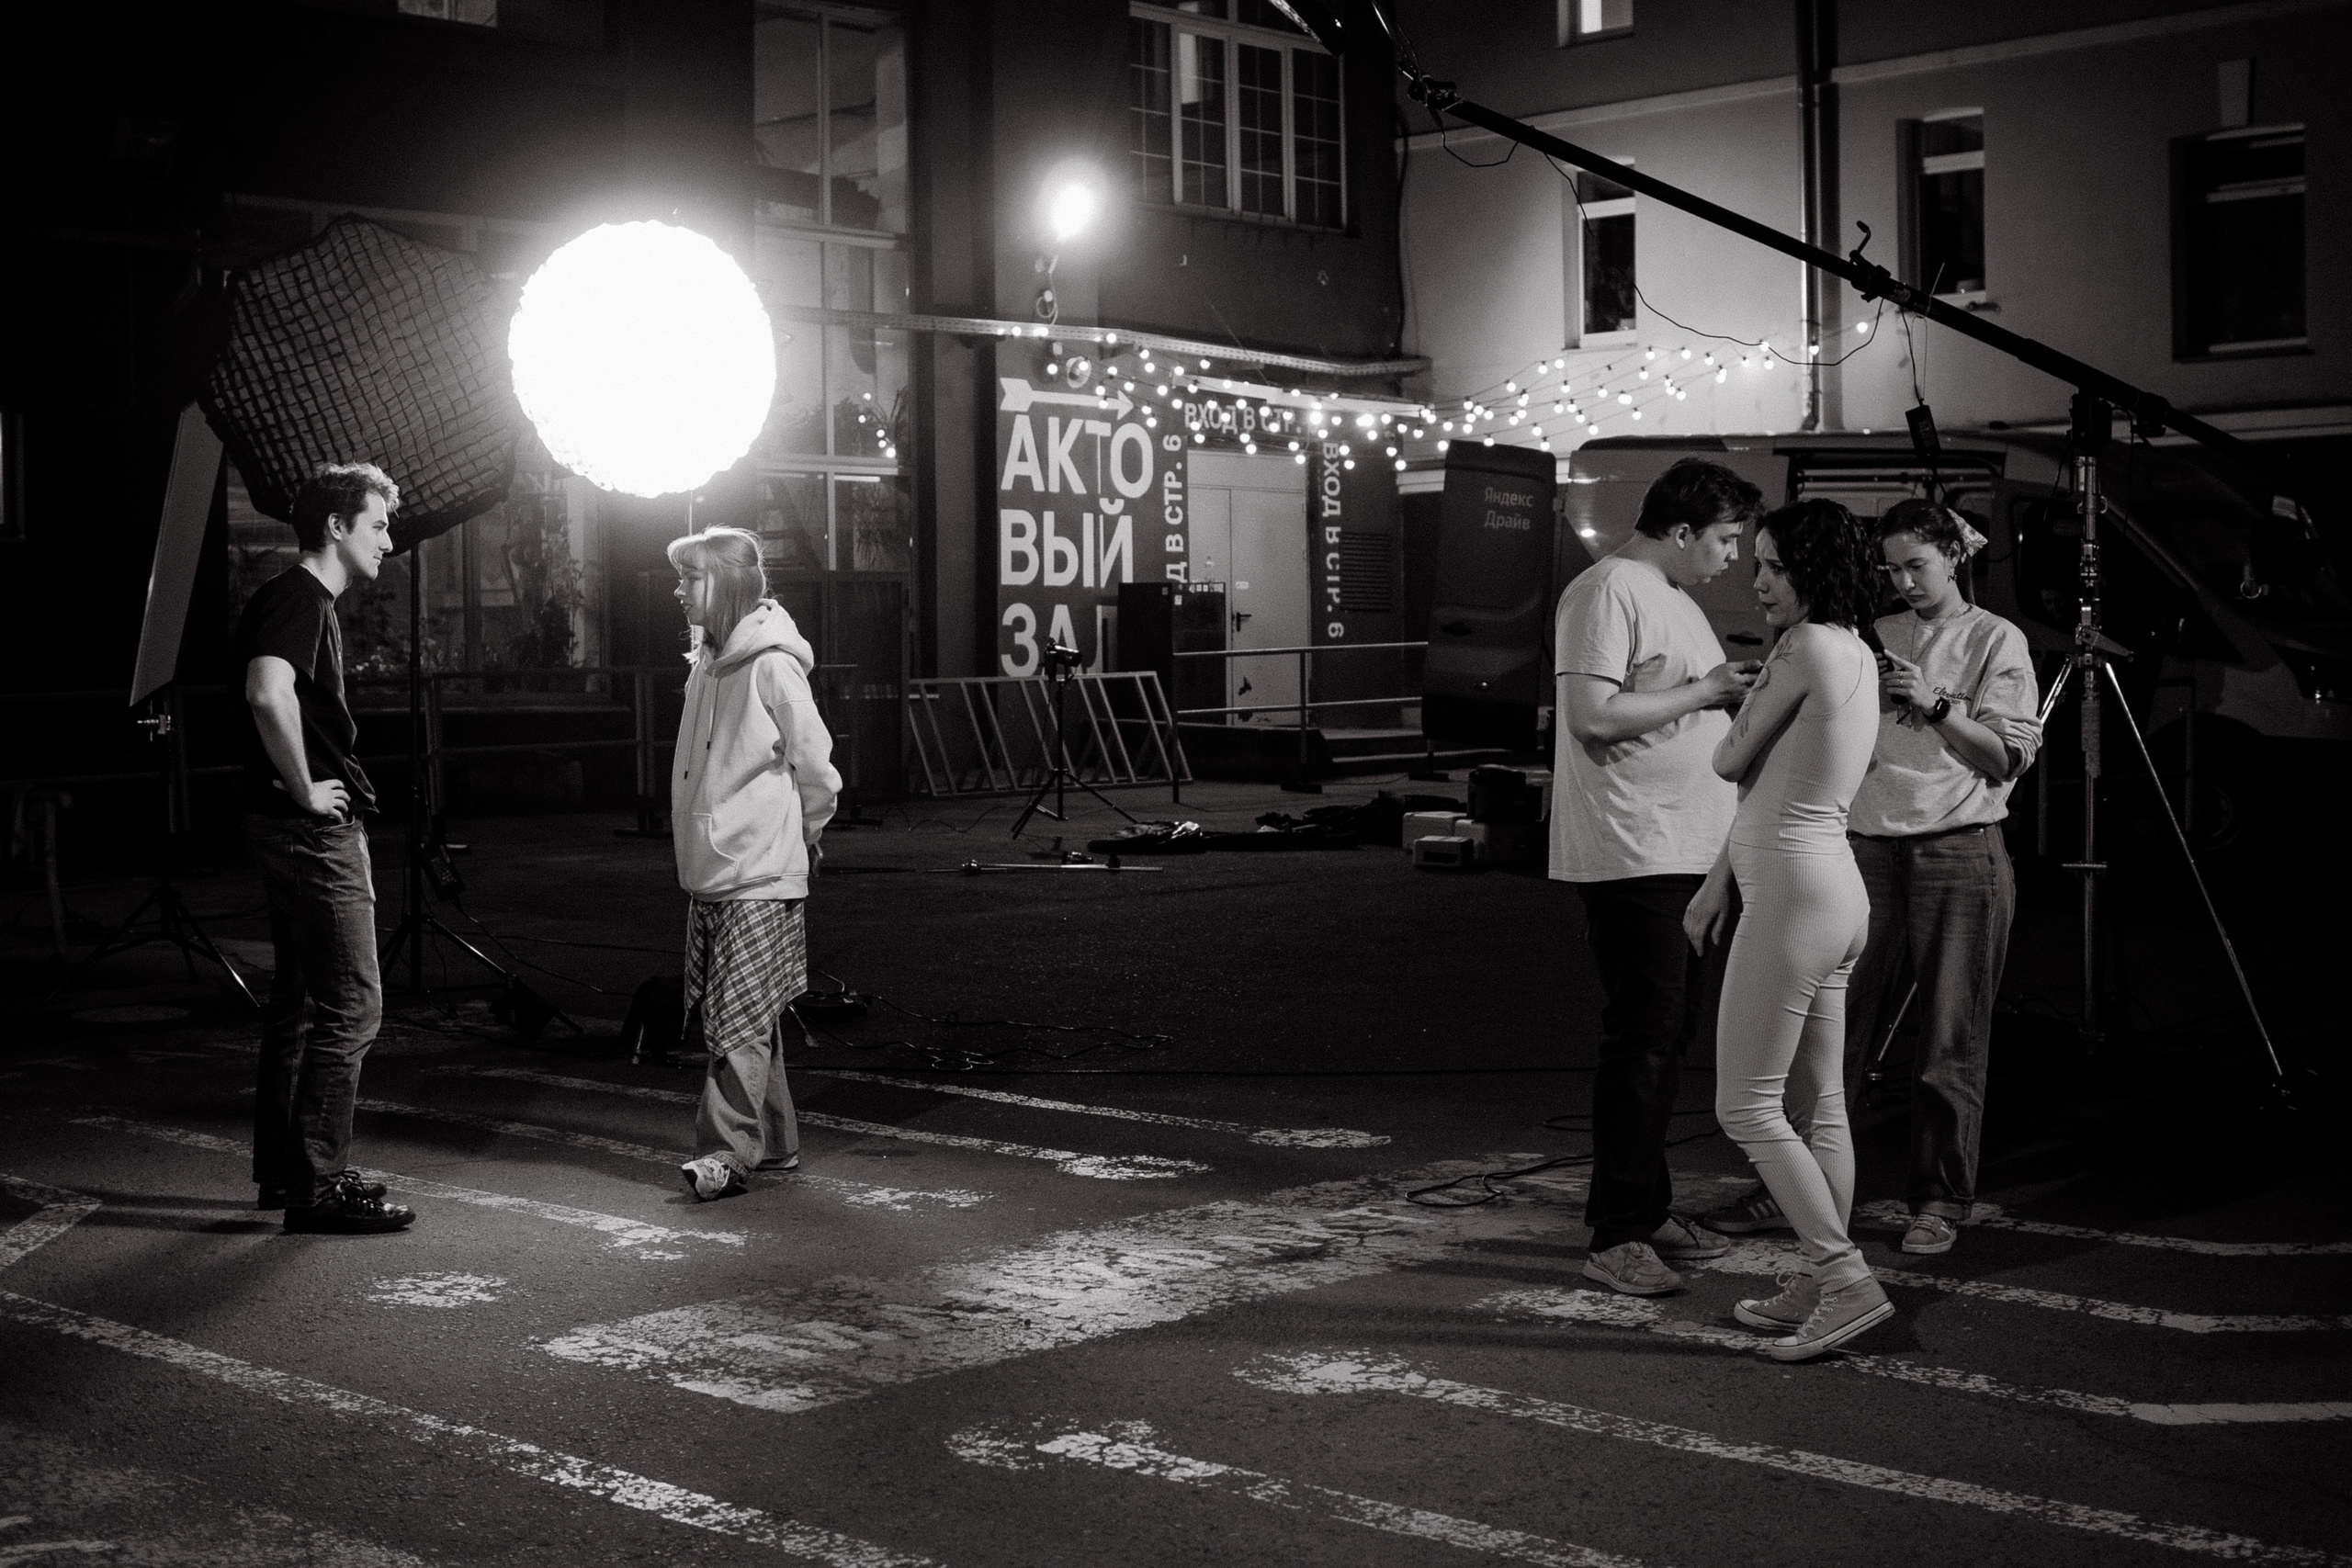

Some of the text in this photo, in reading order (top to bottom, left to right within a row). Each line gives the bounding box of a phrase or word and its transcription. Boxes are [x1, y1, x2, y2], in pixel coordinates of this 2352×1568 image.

[1184, 402, 1238, 434] ВХОД
[1243, 406, 1256, 430] В
[1001, 414, 1154, 499] АКТО
[1162, 434, 1182, 452] 6
[1163, 461, 1183, 525] СТР.
[1321, 442, 1342, 518] ВХОД
[1484, 486, 1534, 508] Яндекс
[1484, 510, 1531, 530] Драйв
[1000, 497, 1134, 589] ВЫЙ
[1328, 622, 1345, 638] 6
